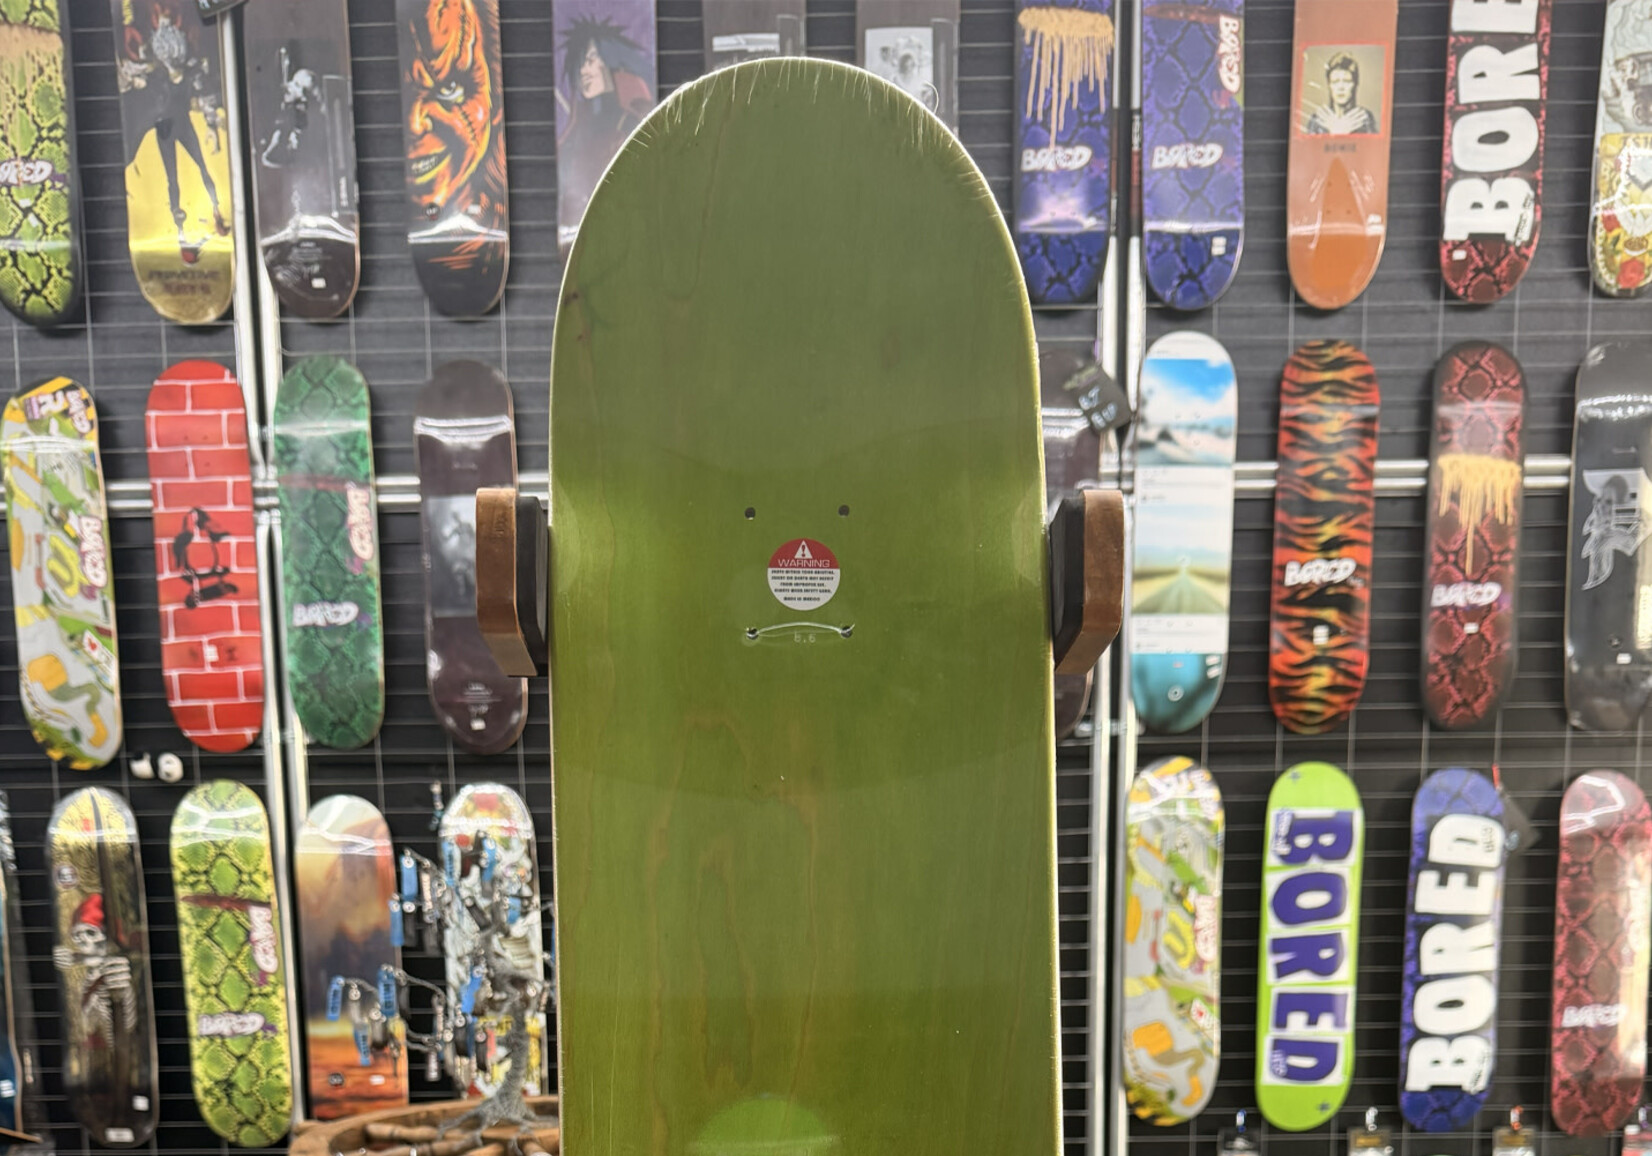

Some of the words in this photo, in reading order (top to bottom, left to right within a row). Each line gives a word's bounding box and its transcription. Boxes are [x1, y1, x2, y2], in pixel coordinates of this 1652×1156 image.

[0, 160, 53, 186] ORED
[1443, 0, 1541, 242] BORE
[778, 559, 831, 568] WARNING
[1271, 808, 1354, 1083] BORED
[1405, 813, 1505, 1092] BORED
